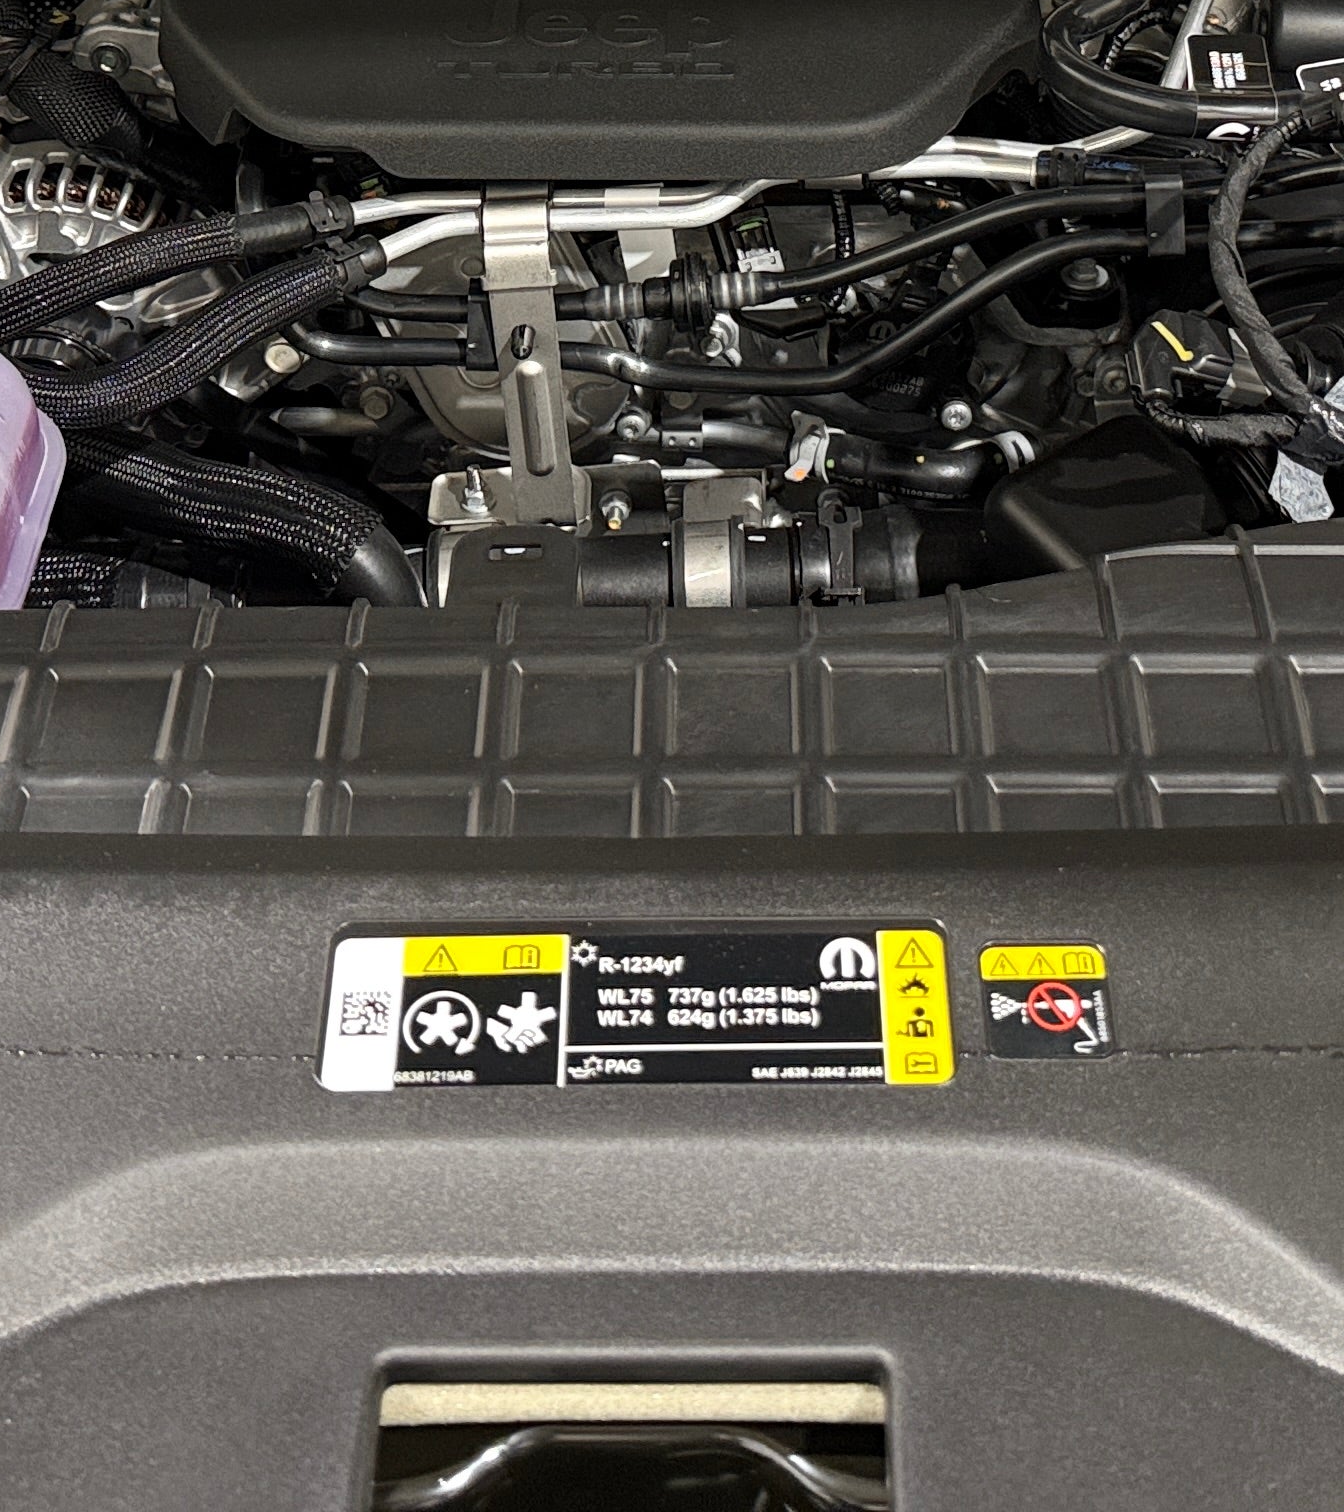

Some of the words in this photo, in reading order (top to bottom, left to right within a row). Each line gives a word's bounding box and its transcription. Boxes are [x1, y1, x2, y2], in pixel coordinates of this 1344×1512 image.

[435, 61, 735, 80] TURBO
[598, 955, 686, 976] R-1234yf
[598, 987, 655, 1005] WL75
[668, 987, 716, 1007] 737g
[718, 986, 779, 1007] (1.625
[781, 986, 821, 1006] lbs)
[597, 1009, 655, 1027] WL74
[667, 1009, 717, 1029] 624g
[718, 1007, 779, 1029] (1.375
[781, 1007, 822, 1029] lbs)
[605, 1057, 644, 1075] PAG
[751, 1067, 778, 1079] SAE
